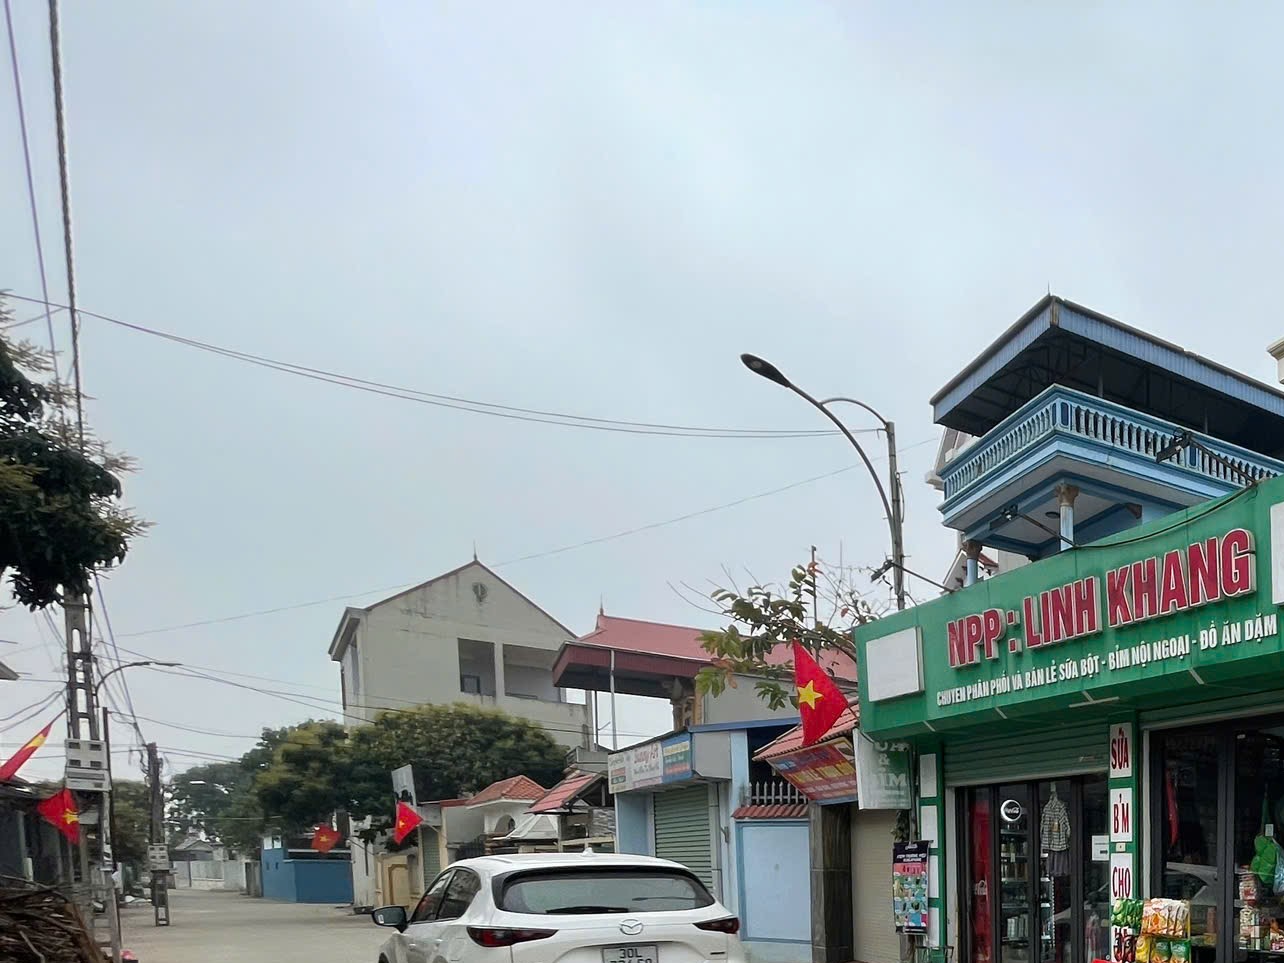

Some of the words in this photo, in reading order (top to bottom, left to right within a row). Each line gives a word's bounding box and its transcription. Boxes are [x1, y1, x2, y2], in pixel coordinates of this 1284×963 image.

[1023, 576, 1101, 649] LINH
[1105, 528, 1256, 628] KHANG
[1025, 666, 1044, 689] BÁN
[1045, 659, 1058, 685] LẺ
[1059, 657, 1079, 681] SỮA
[1080, 653, 1100, 678] BỘT
[1108, 645, 1130, 671] BỈM
[1131, 641, 1151, 667] NỘI
[1152, 634, 1190, 661] NGOẠI
[1199, 620, 1218, 650] ĐỒ
[1221, 620, 1242, 647] ĂN
[1244, 612, 1278, 644] DẶM
[1112, 866, 1131, 899] CHO
[619, 948, 642, 960] 30L
